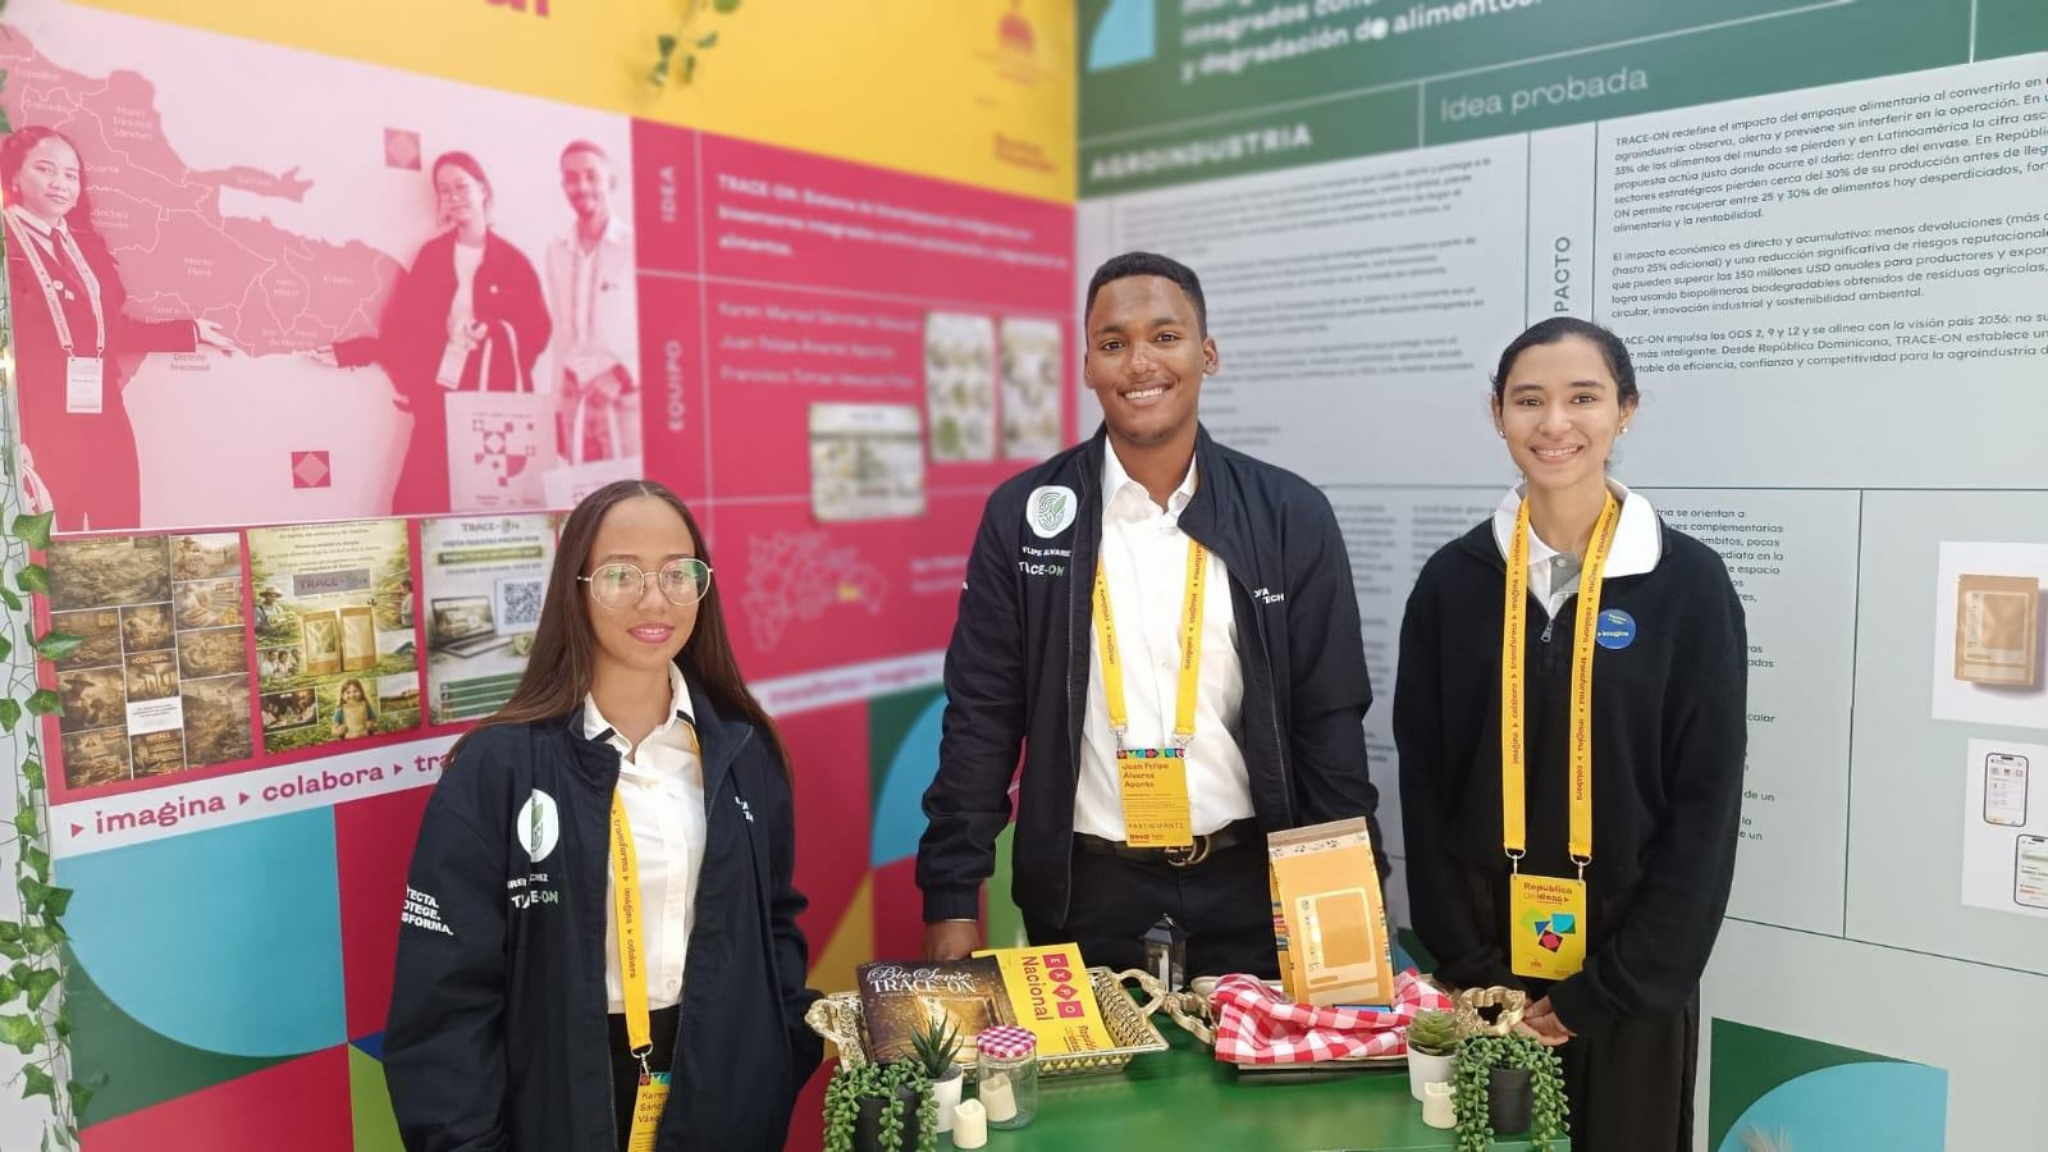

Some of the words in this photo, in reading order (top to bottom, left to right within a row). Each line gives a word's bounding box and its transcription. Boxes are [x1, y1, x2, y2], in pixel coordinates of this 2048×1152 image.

[1440, 93, 1503, 122] Idea
[1511, 65, 1649, 116] probada
[1615, 129, 1669, 145] TRACE-ON
[1671, 123, 1716, 137] redefine
[1718, 121, 1728, 131] el
[1731, 114, 1777, 131] impacto
[1779, 111, 1798, 122] del
[1800, 105, 1856, 122] empaque
[1858, 92, 1930, 112] alimentario
[1933, 90, 1946, 101] al
[1948, 80, 2021, 99] convertirlo
[2024, 79, 2042, 89] en
[1614, 142, 1686, 162] agroindustria:
[1688, 135, 1736, 152] observa,
[1738, 130, 1772, 143] alerta
[1774, 131, 1782, 140] y
[1784, 122, 1835, 139] previene
[1837, 119, 1855, 130] sin
[1857, 111, 1912, 128] interferir
[1915, 111, 1931, 120] en
[1934, 107, 1946, 117] la
[1949, 97, 2019, 118] operación.
[2023, 94, 2040, 106] En
[659, 165, 676, 222] IDEA
[1614, 190, 1656, 203] sectores
[1658, 182, 1723, 199] estratégicos
[1725, 176, 1768, 192] pierden
[1770, 174, 1801, 185] cerca
[1804, 170, 1823, 181] del
[1852, 164, 1868, 175] de
[1871, 165, 1885, 173] su
[1888, 154, 1959, 173] producción
[1962, 149, 1999, 162] antes
[2002, 146, 2020, 158] de
[1612, 217, 1671, 232] alimentaria
[1673, 218, 1680, 227] y
[1682, 215, 1692, 224] la
[1695, 207, 1764, 223] rentabilidad.
[1612, 251, 1622, 260] El
[1624, 247, 1666, 261] impacto
[1668, 241, 1726, 255] económico
[1728, 242, 1741, 250] es
[1742, 236, 1782, 248] directo
[1785, 237, 1793, 246] y
[1795, 227, 1871, 243] acumulativo:
[1874, 225, 1915, 236] menos
[1917, 215, 2002, 232] devoluciones
[1611, 281, 1631, 291] que
[1633, 276, 1671, 289] pueden
[1674, 274, 1714, 286] superar
[1716, 271, 1732, 280] los
[1756, 265, 1802, 277] millones
[1805, 262, 1831, 273] USD
[1834, 258, 1880, 271] anuales
[1883, 258, 1913, 269] para
[1915, 248, 1994, 266] productores
[1997, 250, 2006, 260] y
[1611, 293, 1638, 305] logra
[1751, 277, 1840, 295] biodegradables
[1843, 272, 1903, 286] obtenidos
[1906, 271, 1923, 281] de
[1925, 266, 1979, 280] residuos
[1610, 306, 1650, 319] circular,
[1711, 298, 1763, 310] industrial
[1766, 300, 1773, 308] y
[1775, 292, 1855, 306] sostenibilidad
[1858, 286, 1923, 300] ambiental.
[1637, 350, 1658, 359] más
[1721, 344, 1755, 354] Desde
[1758, 341, 1814, 354] República
[1817, 336, 1892, 351] Dominicana,
[1895, 332, 1961, 345] TRACE-ON
[1965, 329, 2029, 341] establece
[665, 340, 684, 431] EQUIPO
[1690, 509, 1735, 518] orientan
[1690, 523, 1783, 533] complementarias
[1747, 538, 1780, 547] pocas
[1773, 552, 1783, 561] la
[1738, 565, 1780, 575] espacio
[95, 795, 226, 835] imagina
[261, 764, 384, 802] colabora
[614, 818, 629, 872] transforma
[624, 887, 632, 924] imagina
[870, 979, 976, 993] TRACE-ON
[1021, 956, 1054, 1021] Nacional
[1047, 956, 1080, 1015] EXPO
